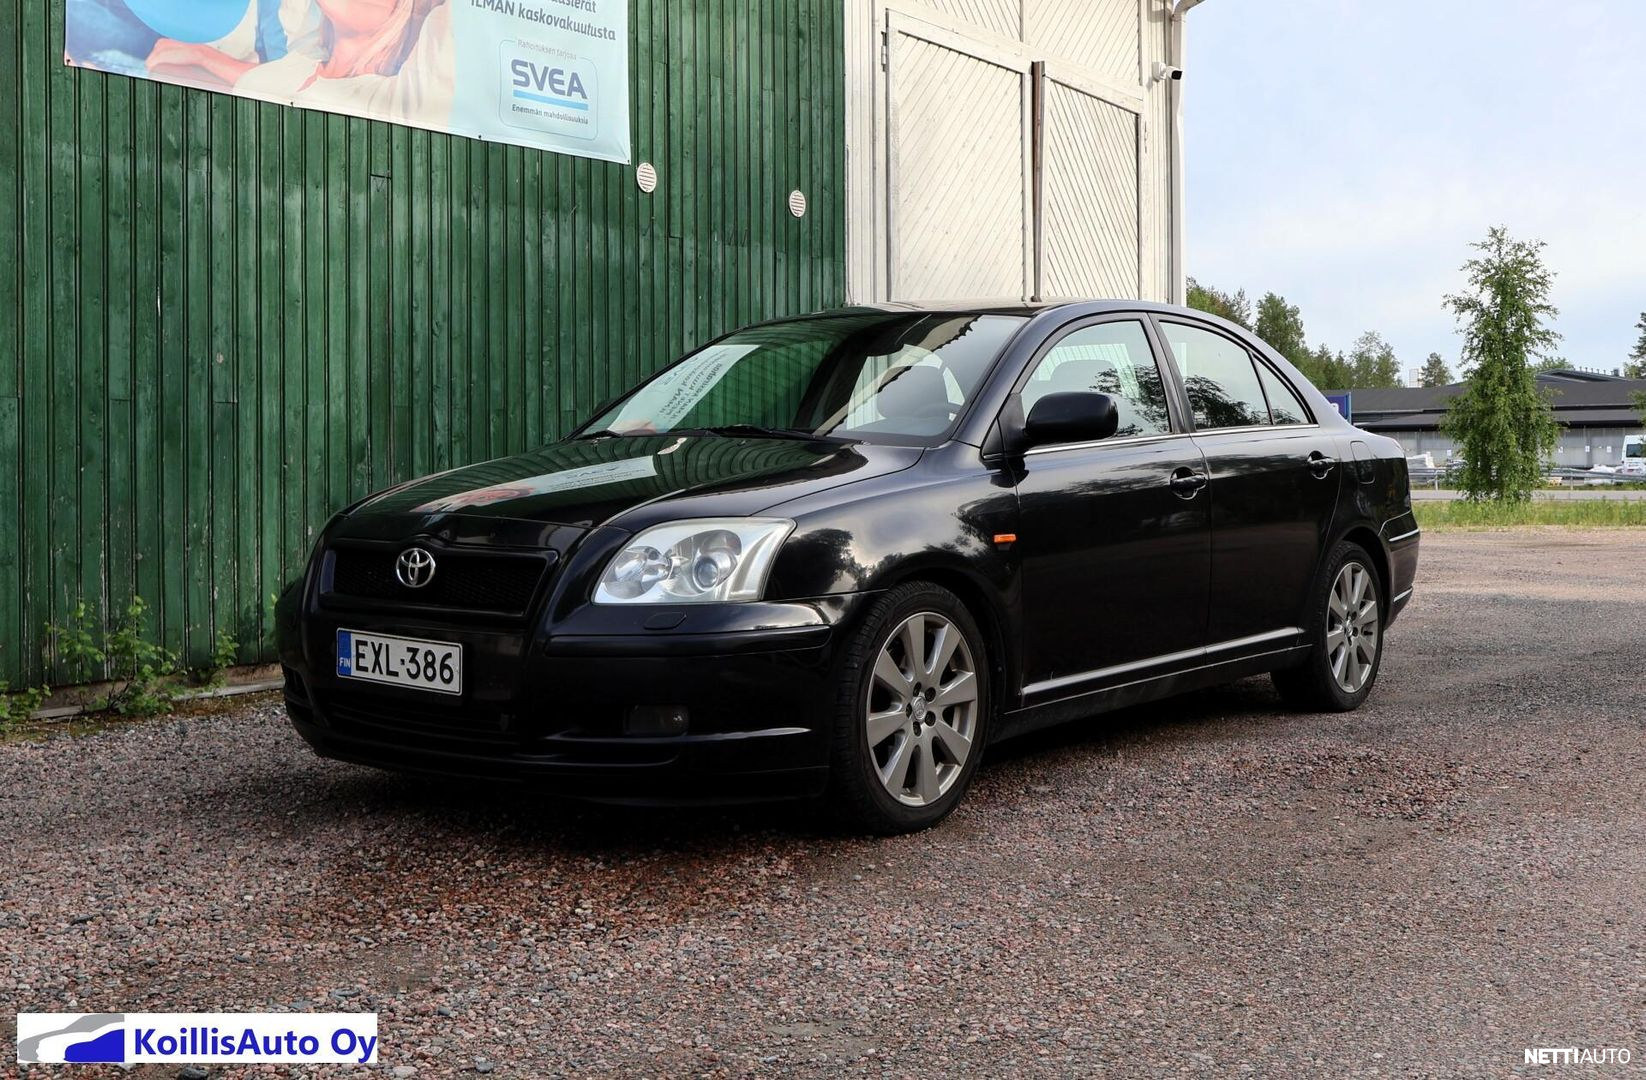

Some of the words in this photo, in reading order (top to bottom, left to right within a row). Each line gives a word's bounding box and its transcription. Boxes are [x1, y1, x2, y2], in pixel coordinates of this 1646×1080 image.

[518, 3, 616, 41] kaskovakuutusta
[511, 59, 588, 100] SVEA
[340, 657, 351, 669] FIN
[355, 639, 454, 685] EXL-386
